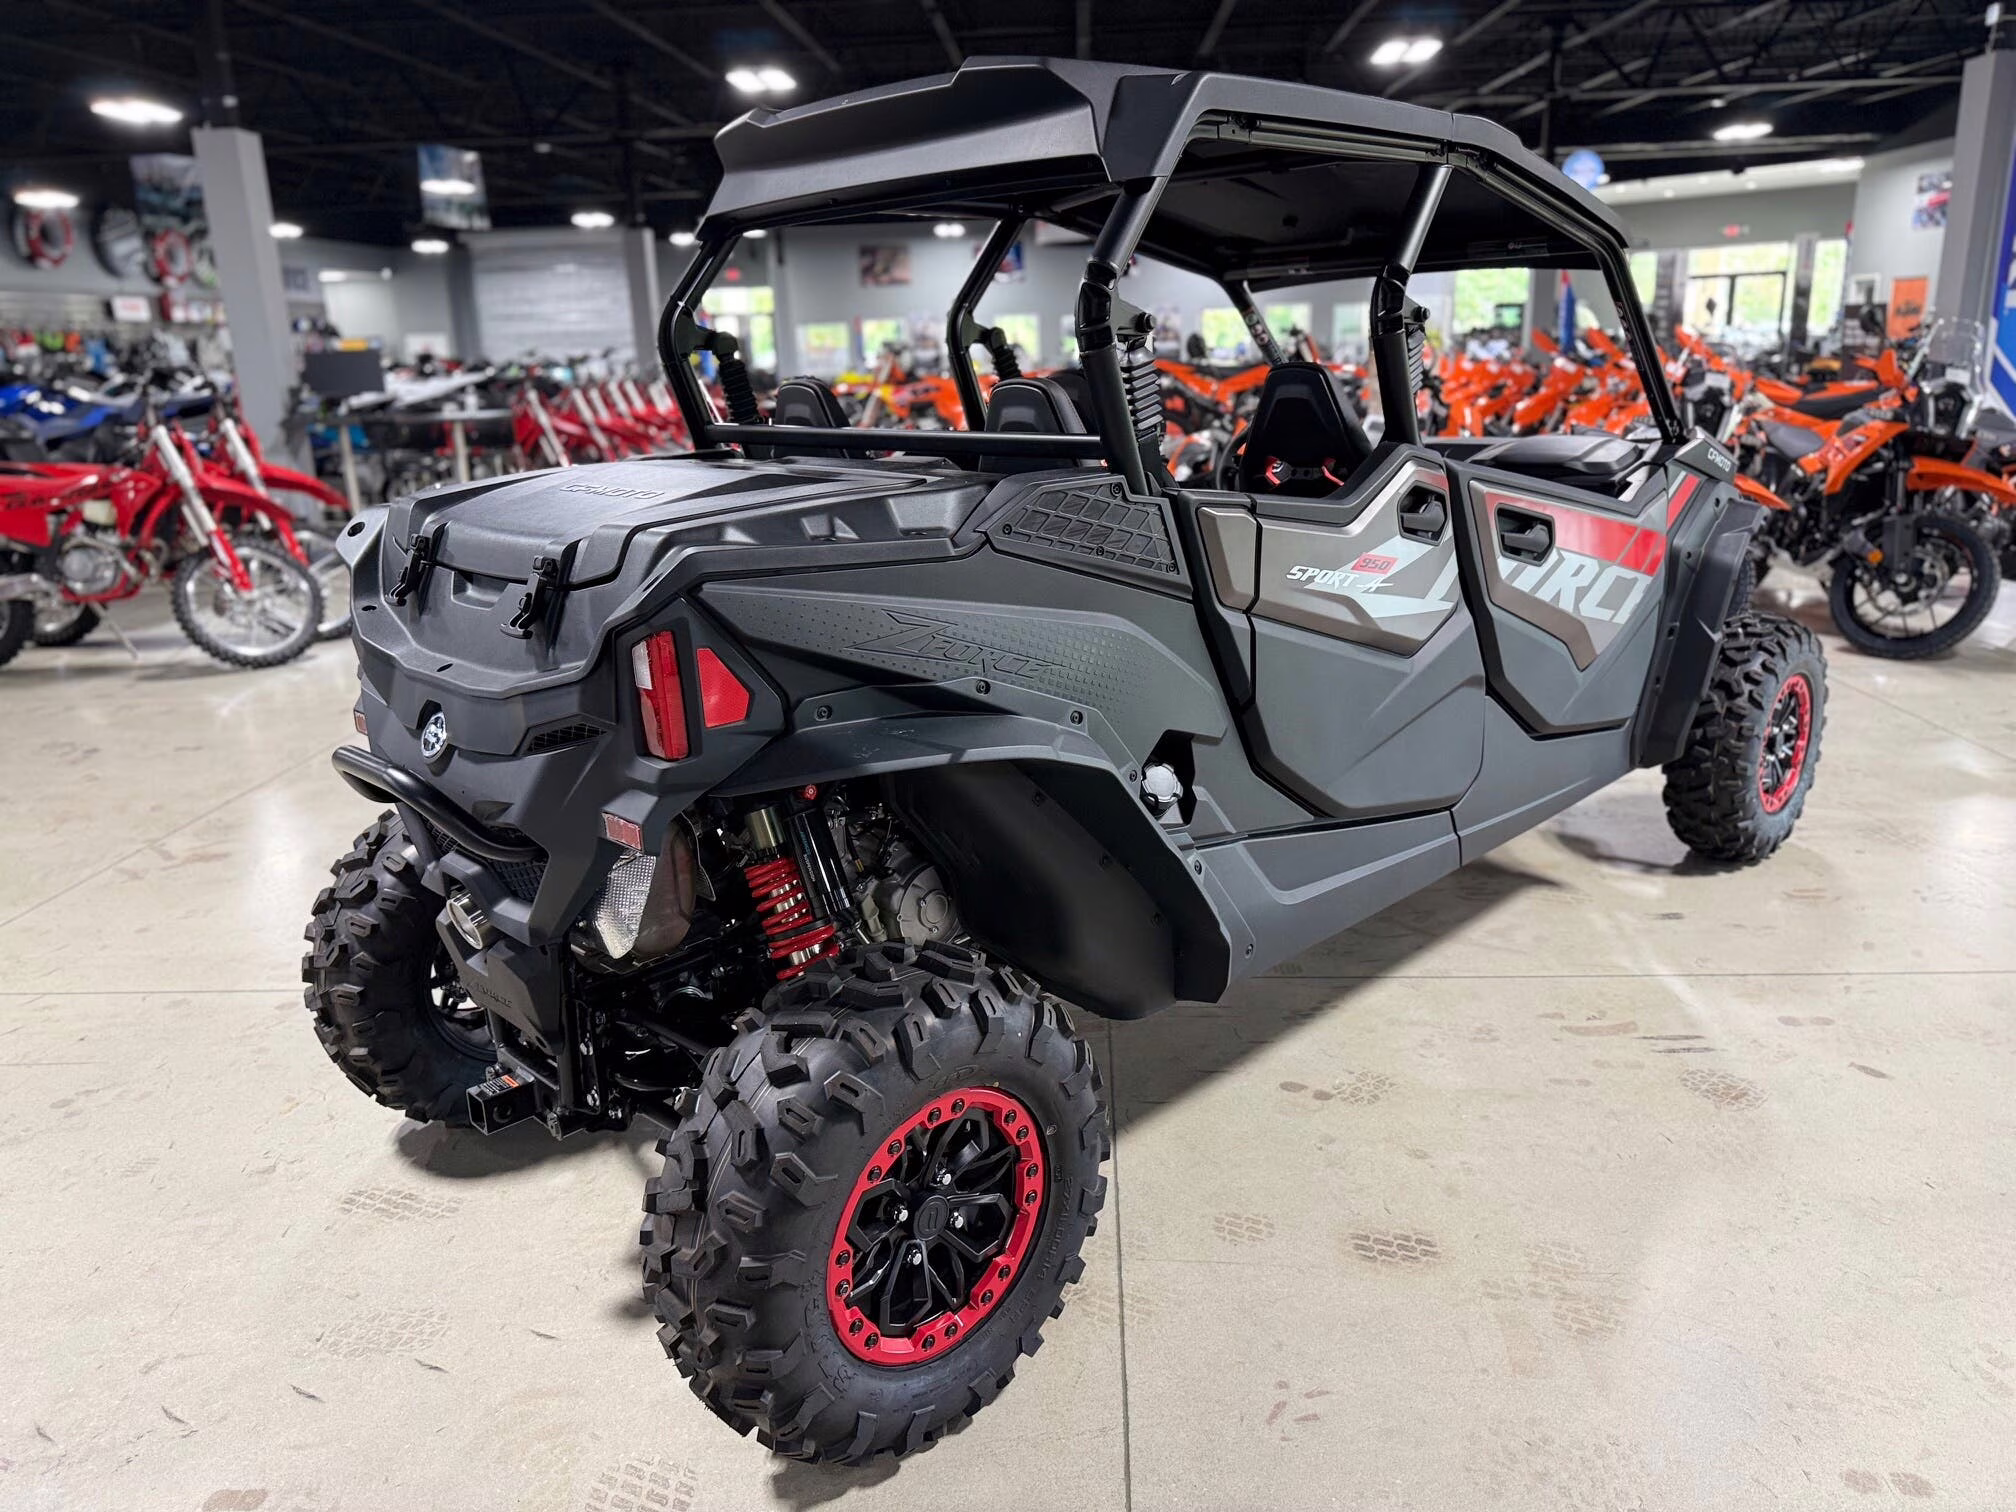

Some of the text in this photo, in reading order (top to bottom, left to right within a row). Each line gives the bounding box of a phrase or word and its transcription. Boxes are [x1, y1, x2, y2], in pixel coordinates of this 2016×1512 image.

[1707, 447, 1732, 472] CFMOTO
[1359, 557, 1391, 571] 950
[1286, 565, 1359, 590] SPORT
